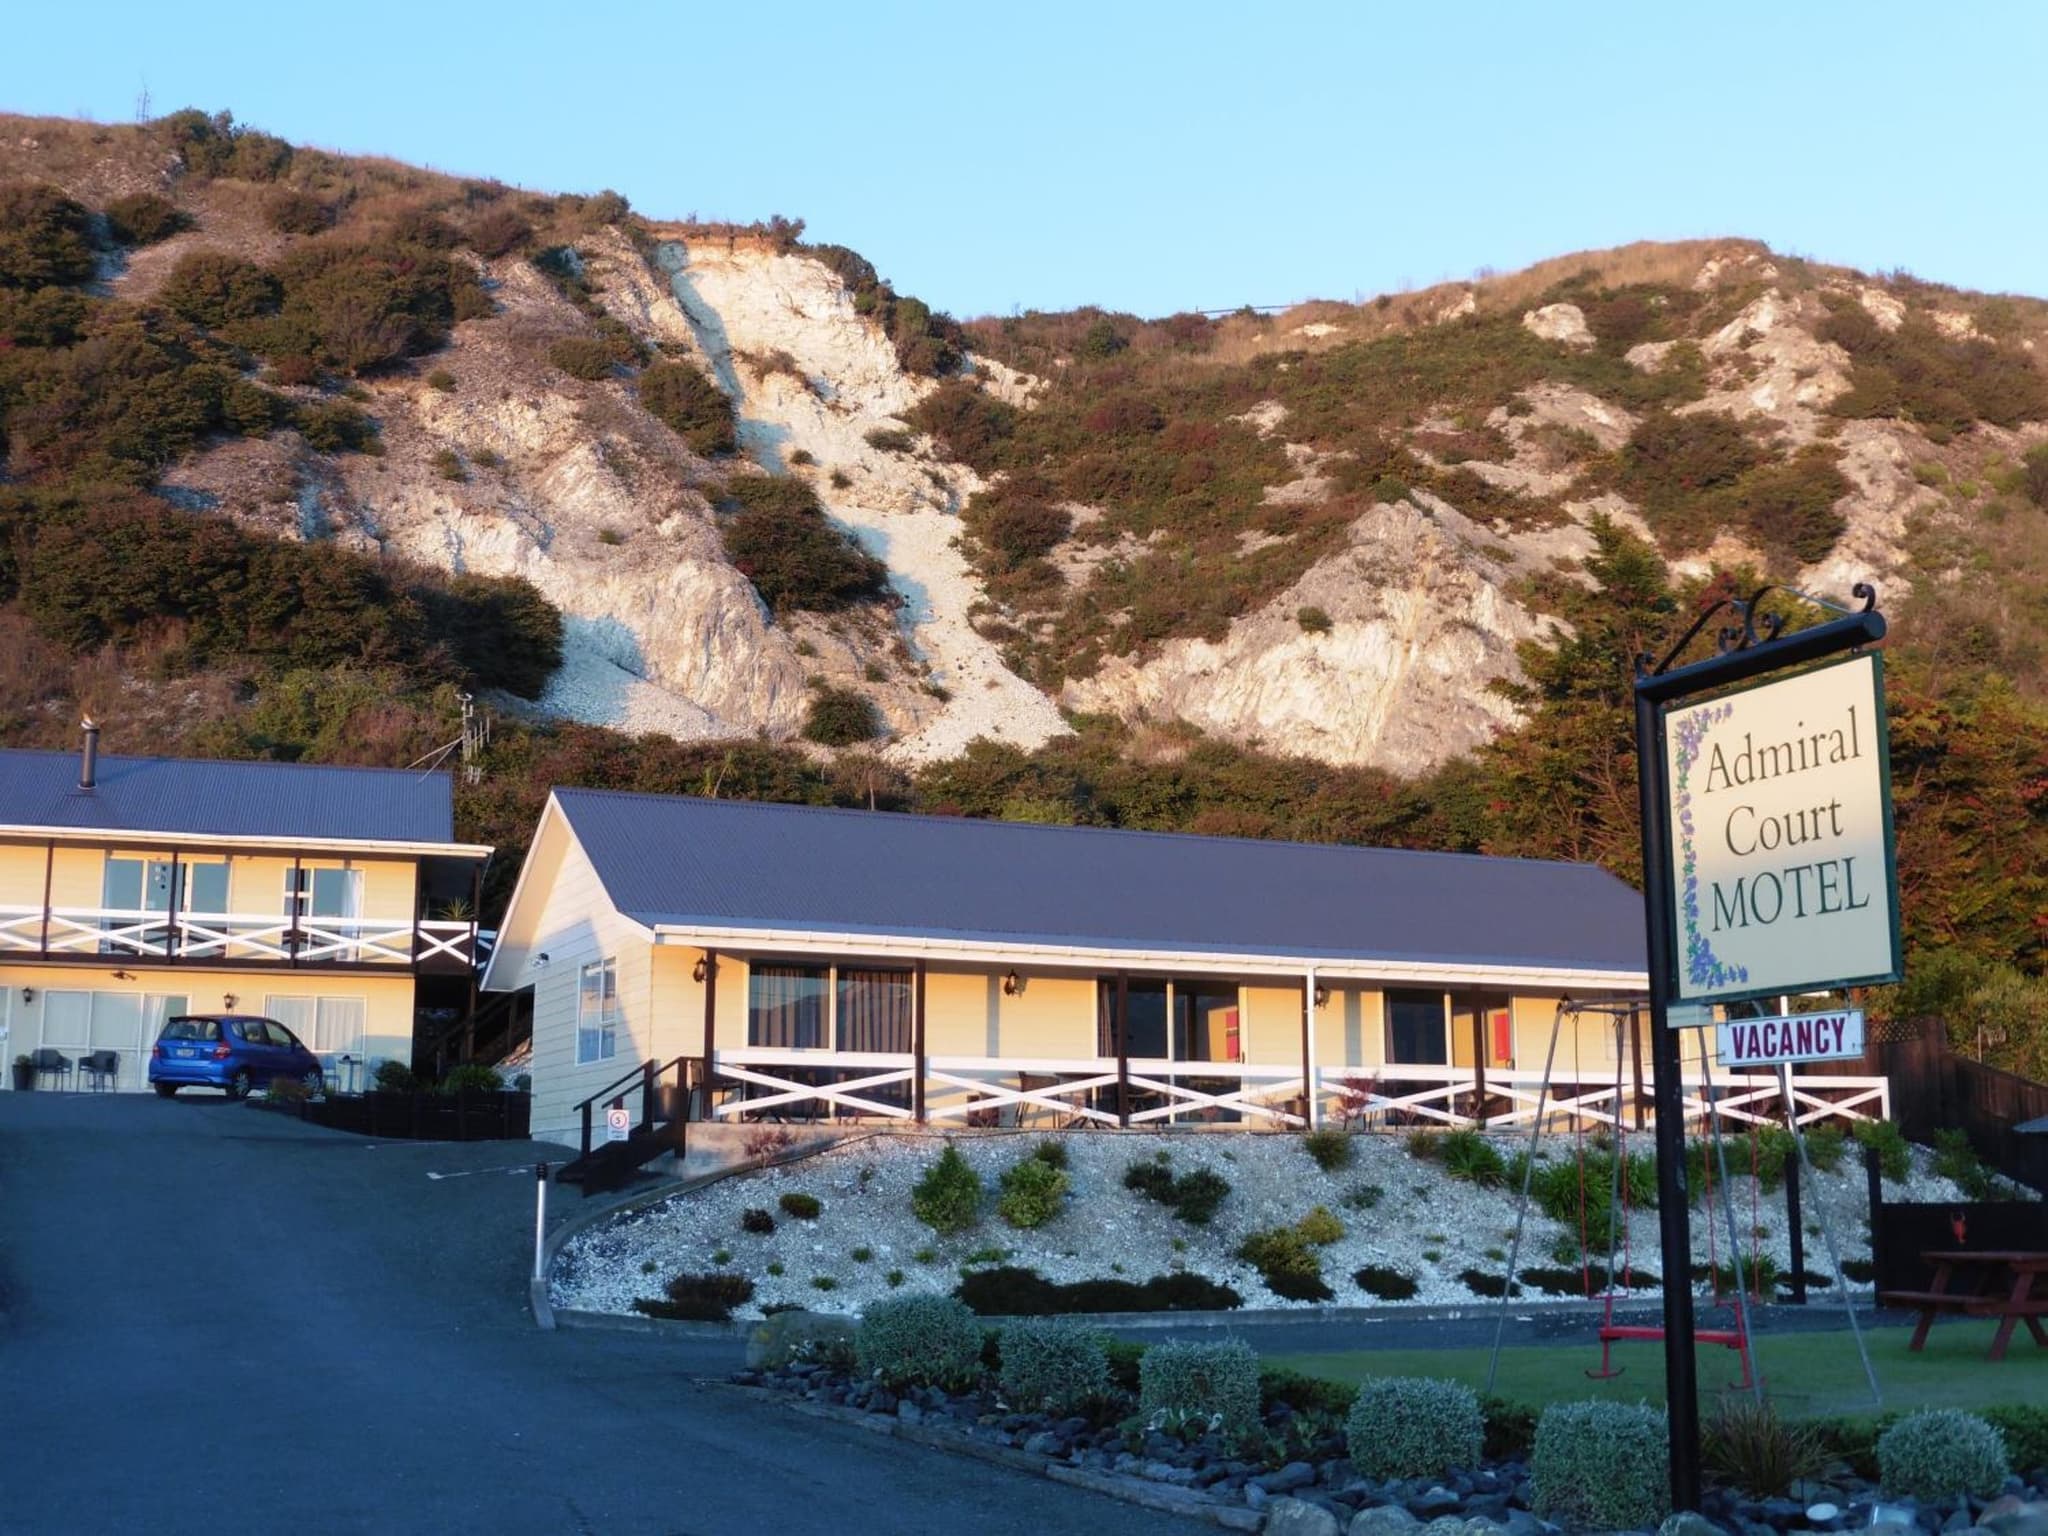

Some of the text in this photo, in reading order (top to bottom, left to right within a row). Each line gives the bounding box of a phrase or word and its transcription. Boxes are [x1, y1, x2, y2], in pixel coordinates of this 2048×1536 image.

[1705, 705, 1862, 793] Admiral
[1725, 798, 1844, 856] Court
[1712, 857, 1870, 932] MOTEL
[1732, 1017, 1846, 1060] VACANCY
